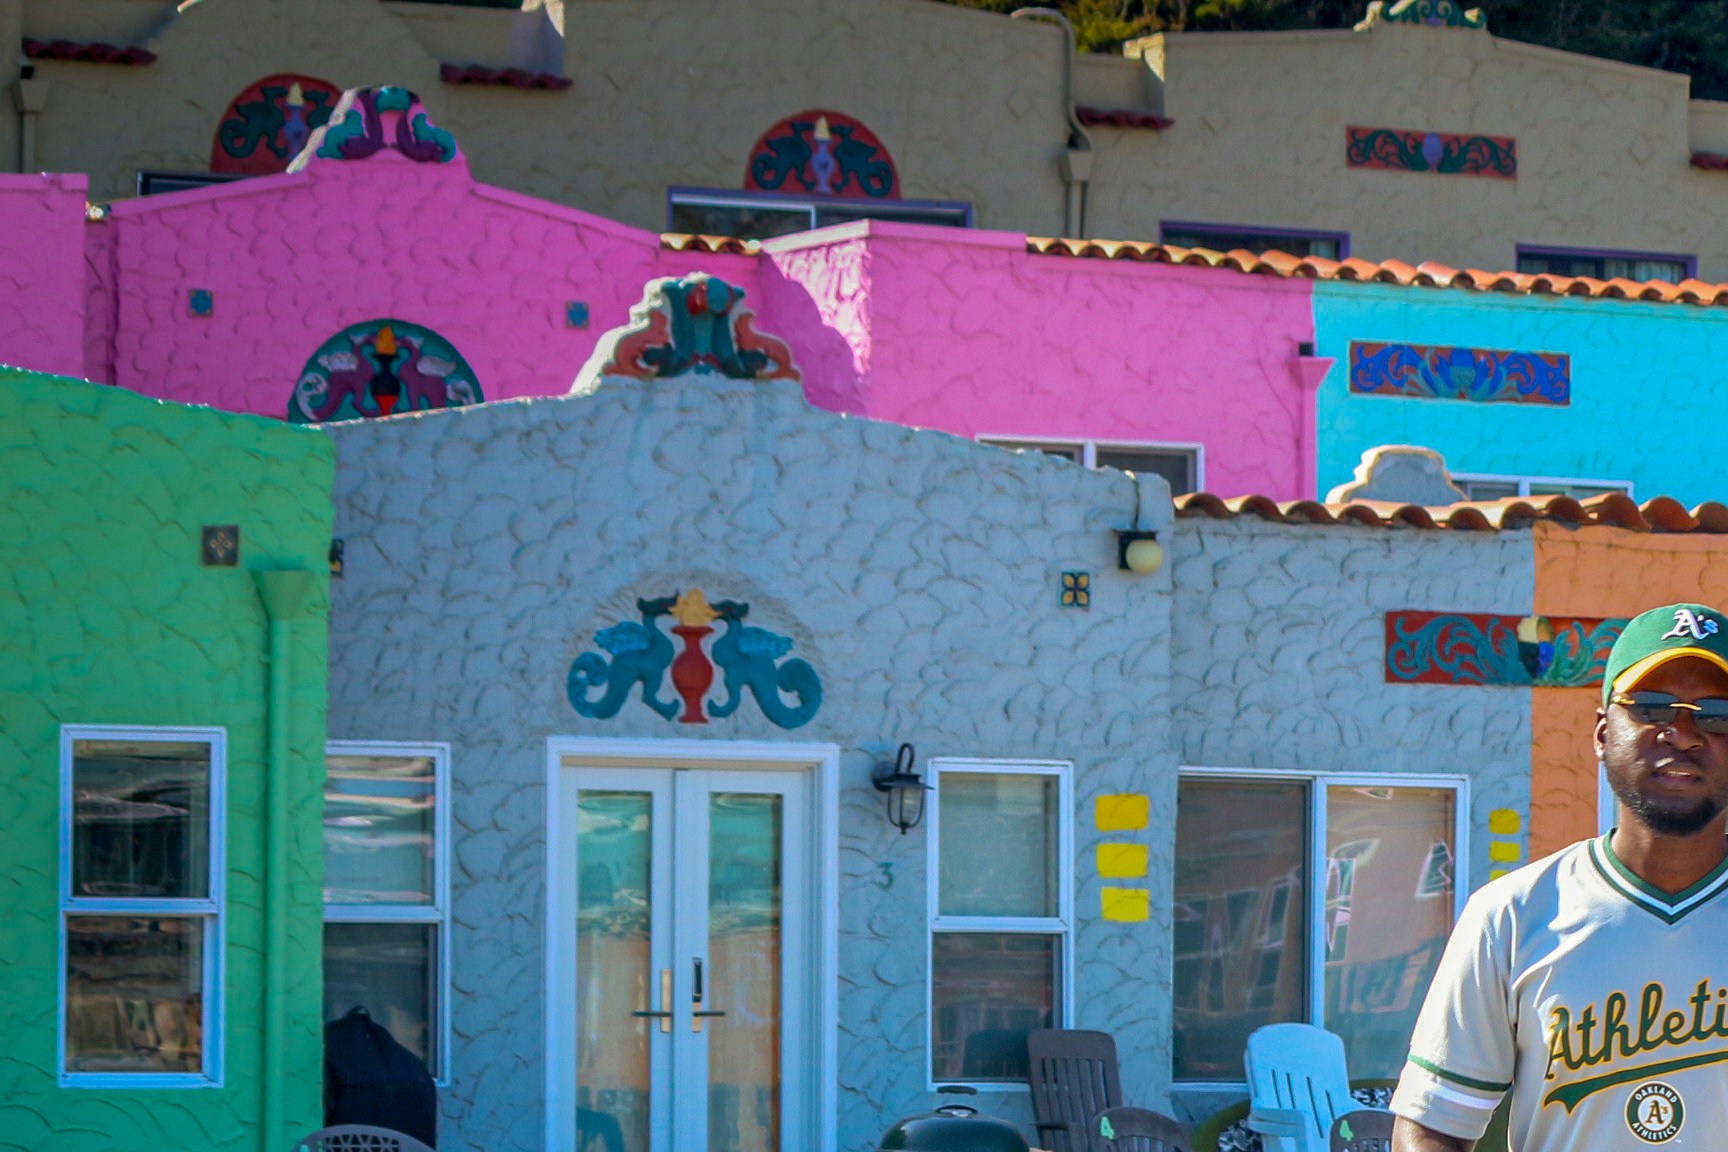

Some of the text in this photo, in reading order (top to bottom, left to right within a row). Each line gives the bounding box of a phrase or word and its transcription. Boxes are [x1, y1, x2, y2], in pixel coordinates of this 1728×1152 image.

[1661, 609, 1719, 640] A's
[876, 861, 894, 892] 3
[1634, 1085, 1678, 1103] OAKLAND
[1644, 1100, 1669, 1124] A's
[1100, 1115, 1115, 1140] 4
[1339, 1119, 1354, 1141] 4
[1631, 1122, 1677, 1140] ATHLETICS
